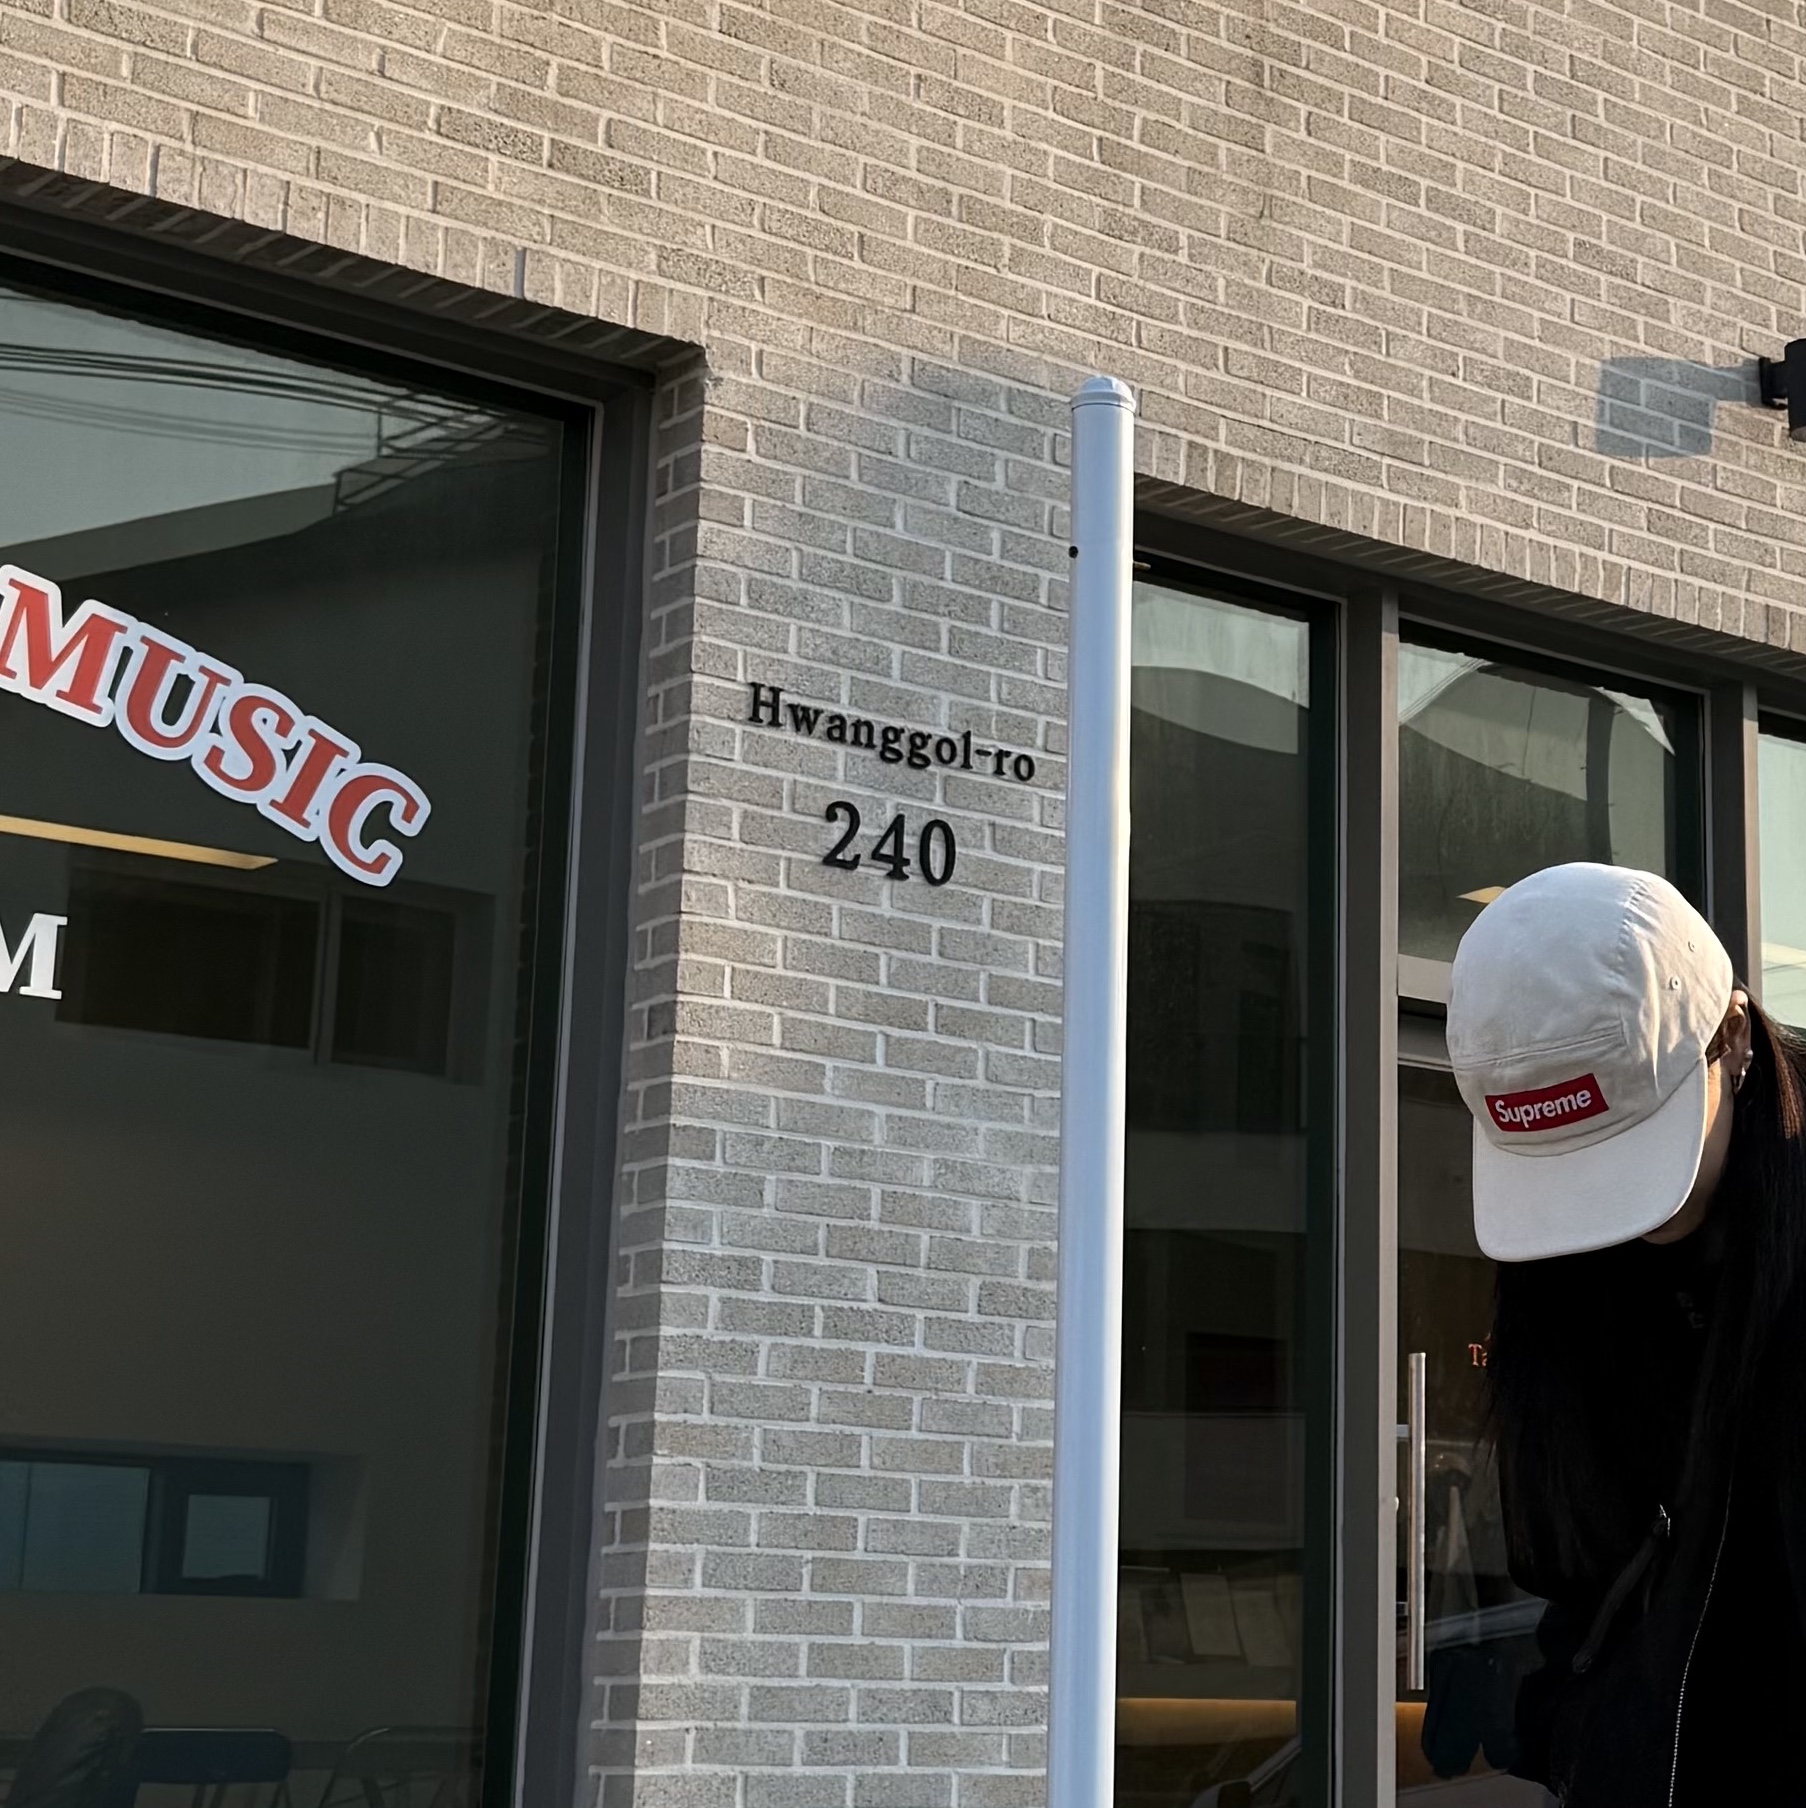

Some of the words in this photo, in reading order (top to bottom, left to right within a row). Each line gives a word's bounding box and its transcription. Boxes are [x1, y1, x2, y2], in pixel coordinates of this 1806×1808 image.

[0, 570, 427, 881] MUSIC
[746, 681, 1036, 782] Hwanggol-ro
[822, 800, 957, 888] 240
[1494, 1088, 1592, 1129] Supreme
